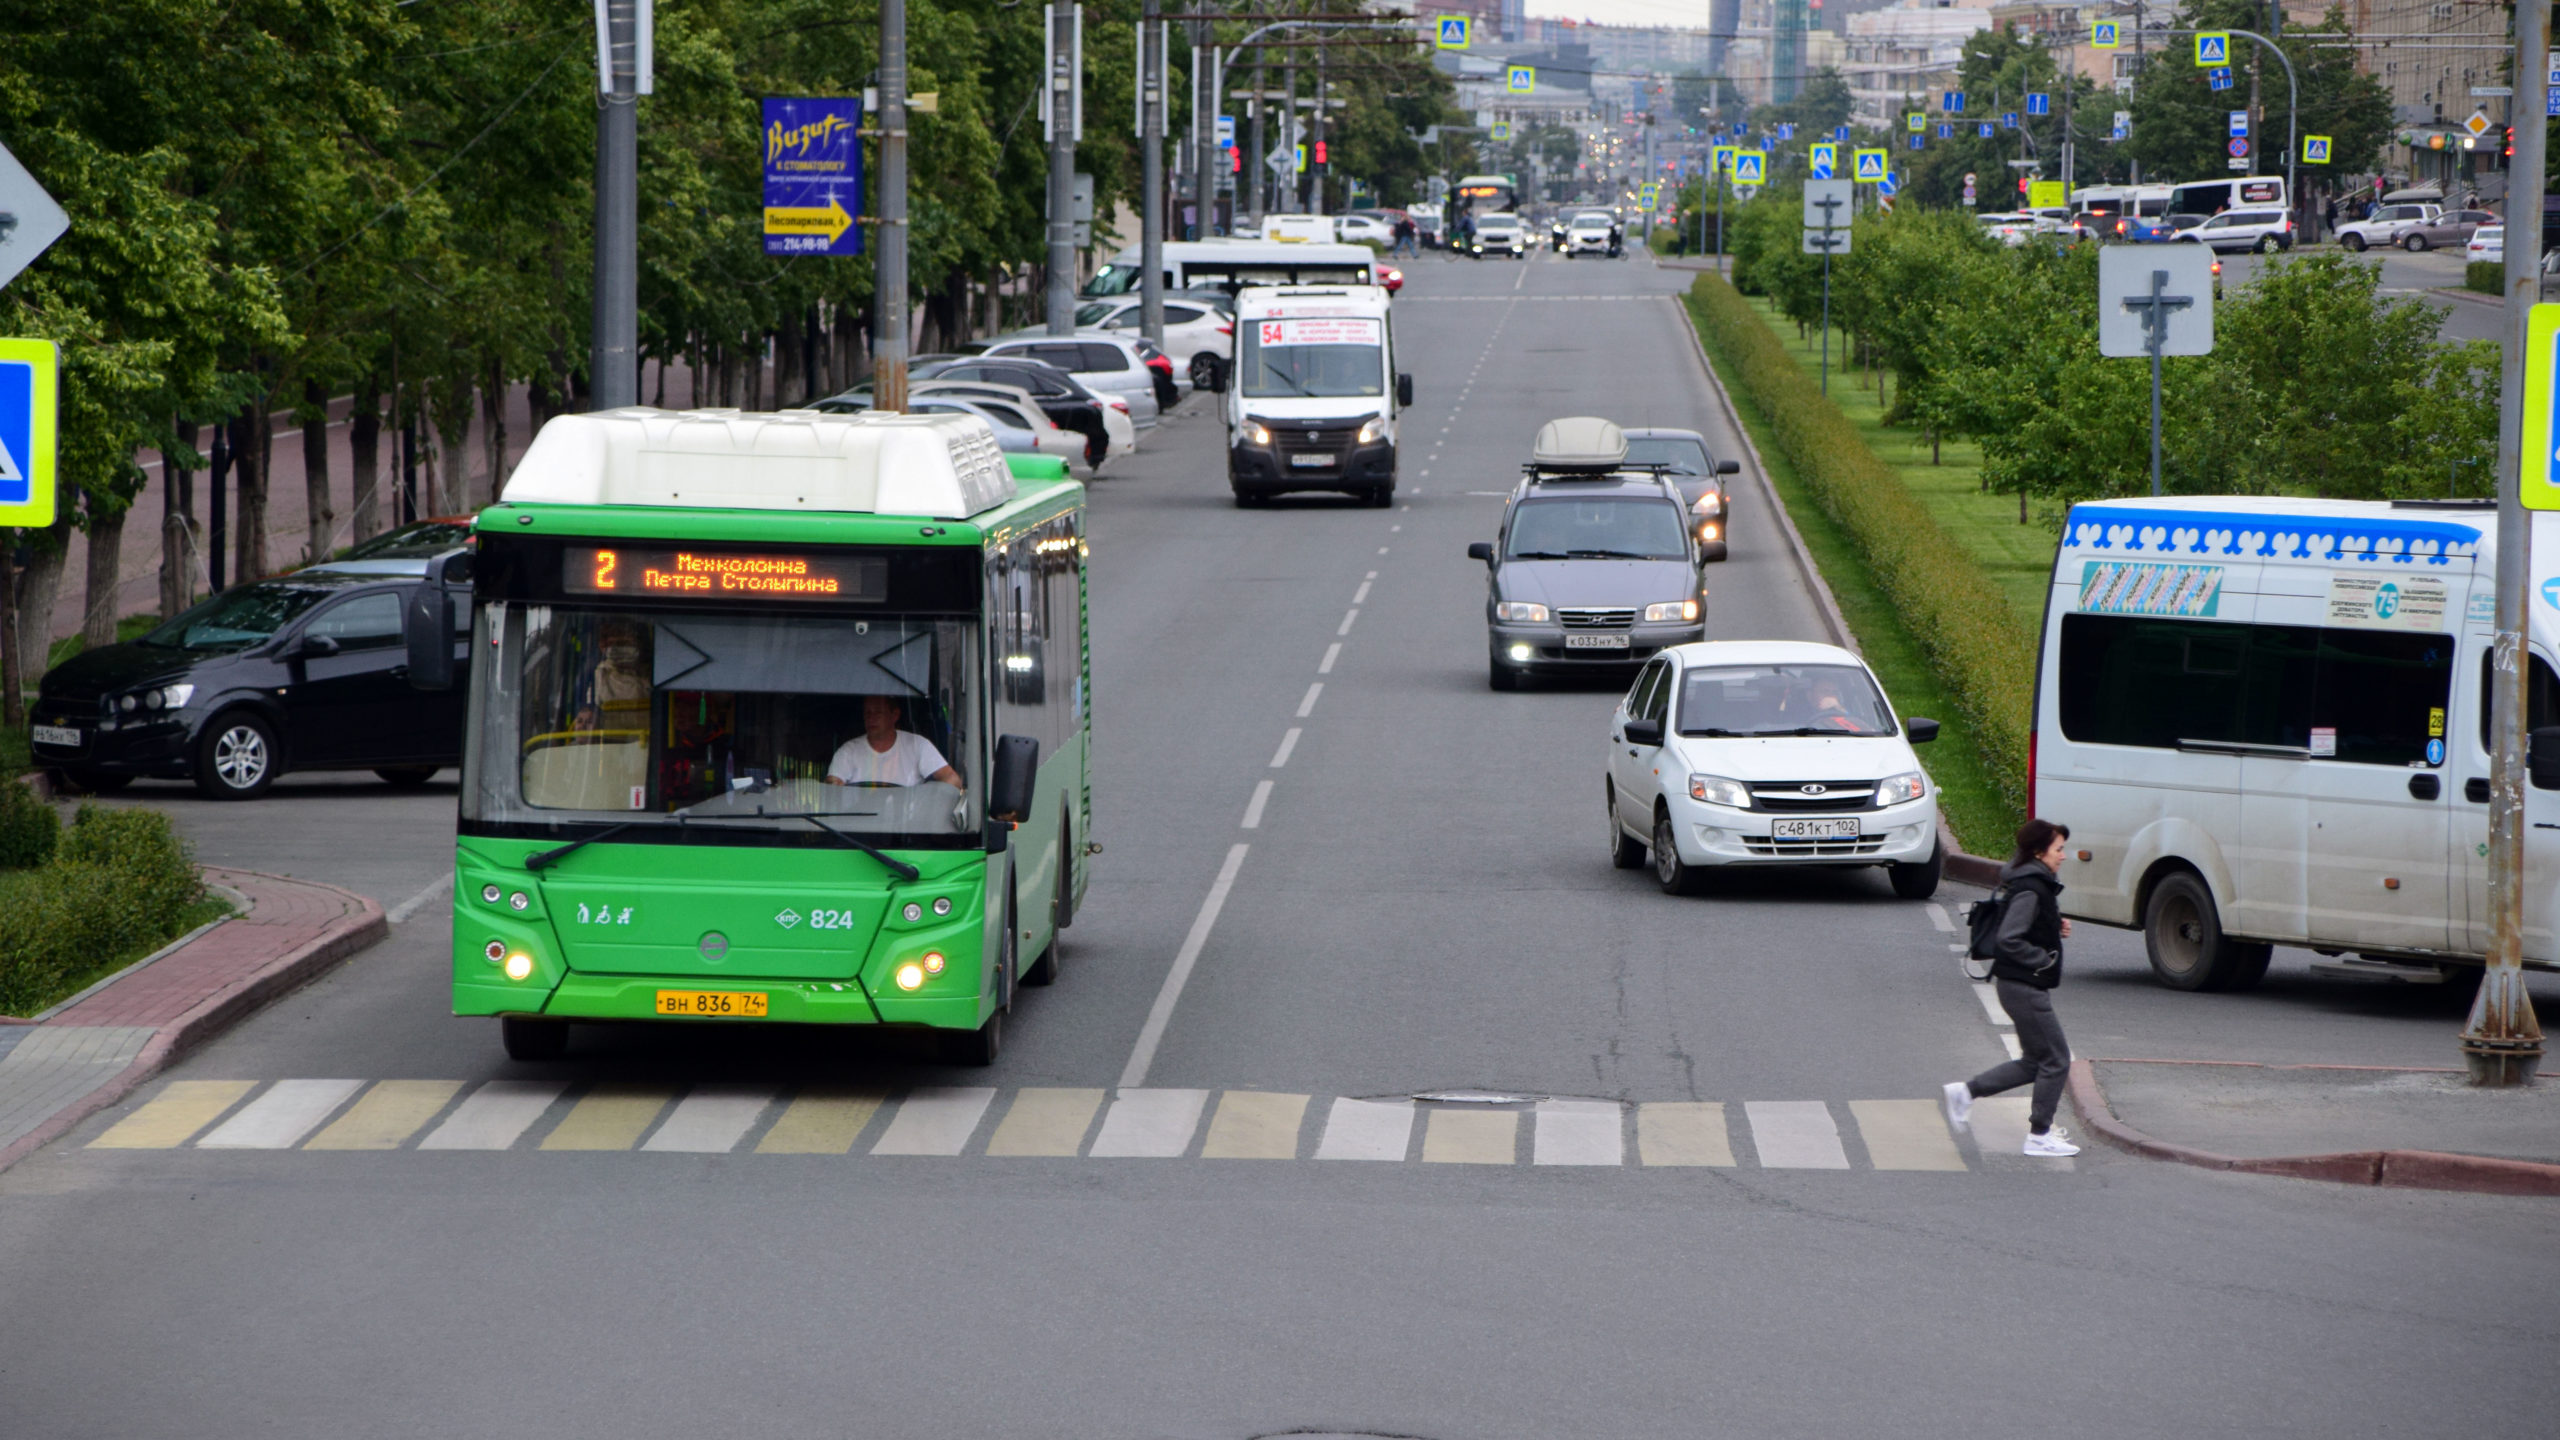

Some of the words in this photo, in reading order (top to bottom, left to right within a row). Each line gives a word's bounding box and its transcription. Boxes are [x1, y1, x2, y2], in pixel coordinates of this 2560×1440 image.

[767, 113, 854, 165] Визит
[784, 161, 846, 171] СТОМАТОЛОГУ
[784, 238, 829, 251] 214-98-98
[1263, 324, 1282, 344] 54
[596, 551, 615, 588] 2
[645, 569, 711, 590] Петра
[722, 573, 838, 593] Столыпина
[2377, 591, 2396, 614] 75
[2431, 714, 2443, 729] 28
[1778, 821, 1832, 837] С481КТ
[1835, 820, 1855, 832] 102
[810, 909, 854, 930] 824
[667, 998, 688, 1011] ВН
[697, 995, 731, 1012] 836
[743, 995, 760, 1008] 74
